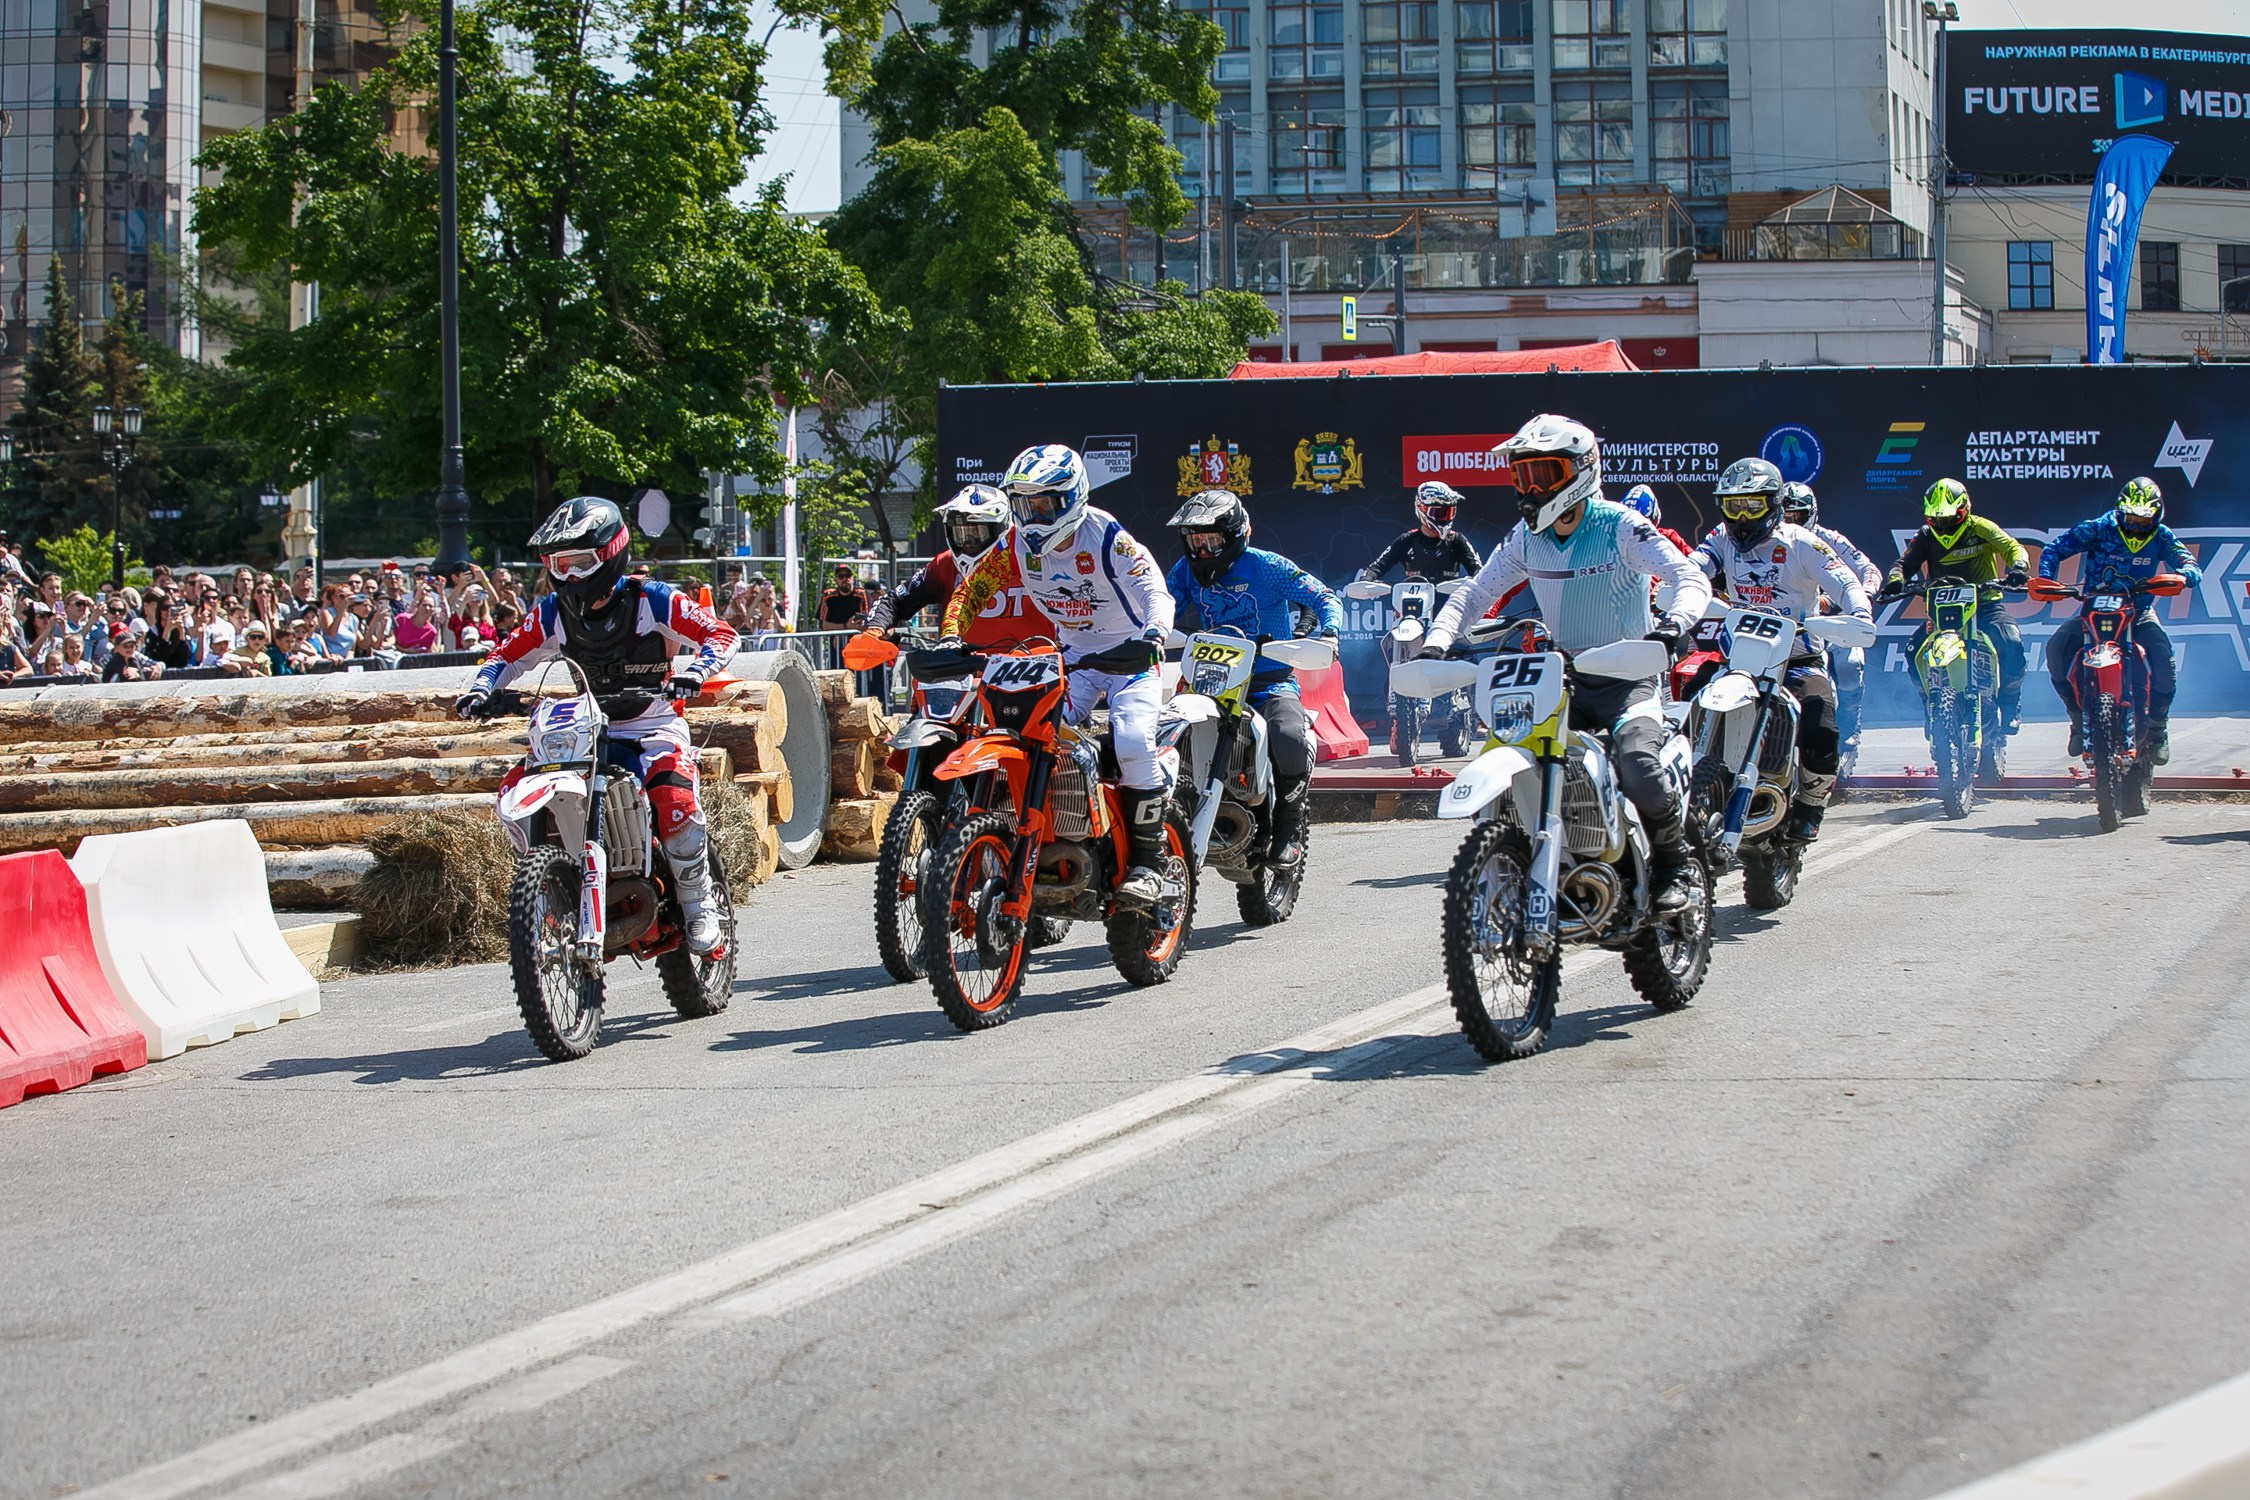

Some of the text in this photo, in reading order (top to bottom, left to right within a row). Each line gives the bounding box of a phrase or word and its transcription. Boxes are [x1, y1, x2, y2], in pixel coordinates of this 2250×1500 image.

[1985, 45, 2067, 59] НАРУЖНАЯ
[2070, 45, 2138, 58] РЕКЛАМА
[2140, 47, 2150, 58] В
[1964, 86, 2100, 114] FUTURE
[1966, 431, 2100, 446] ДЕПАРТАМЕНТ
[1086, 451, 1129, 460] НАЦИОНАЛЬНЫЕ
[1602, 443, 1719, 456] МИНИСТЕРСТВО
[1966, 448, 2065, 462] КУЛЬТУРЫ
[956, 457, 983, 470] При
[1416, 450, 1441, 473] 80
[1602, 459, 1719, 472] КУЛЬТУРЫ
[1602, 472, 1719, 483] СВЕРДЛОВСКОЙ ОБЛАСТИ
[1866, 469, 1923, 477] ДЕПАРТАМЕНТ
[1966, 465, 2114, 479] ЕКАТЕРИНБУРГА
[2132, 557, 2152, 566] 66
[1234, 583, 1250, 593] 807
[1408, 584, 1421, 595] 47
[1735, 585, 1771, 595] ЮЖНЫЙ
[1750, 595, 1772, 604] УРАЛ
[1935, 588, 1962, 602] 911
[1045, 598, 1090, 609] ЮЖНЫЙ
[1065, 608, 1093, 618] УРАЛ
[1734, 614, 1783, 639] 86
[1194, 646, 1240, 664] 807
[988, 661, 1050, 686] 444
[1489, 656, 1546, 690] 26
